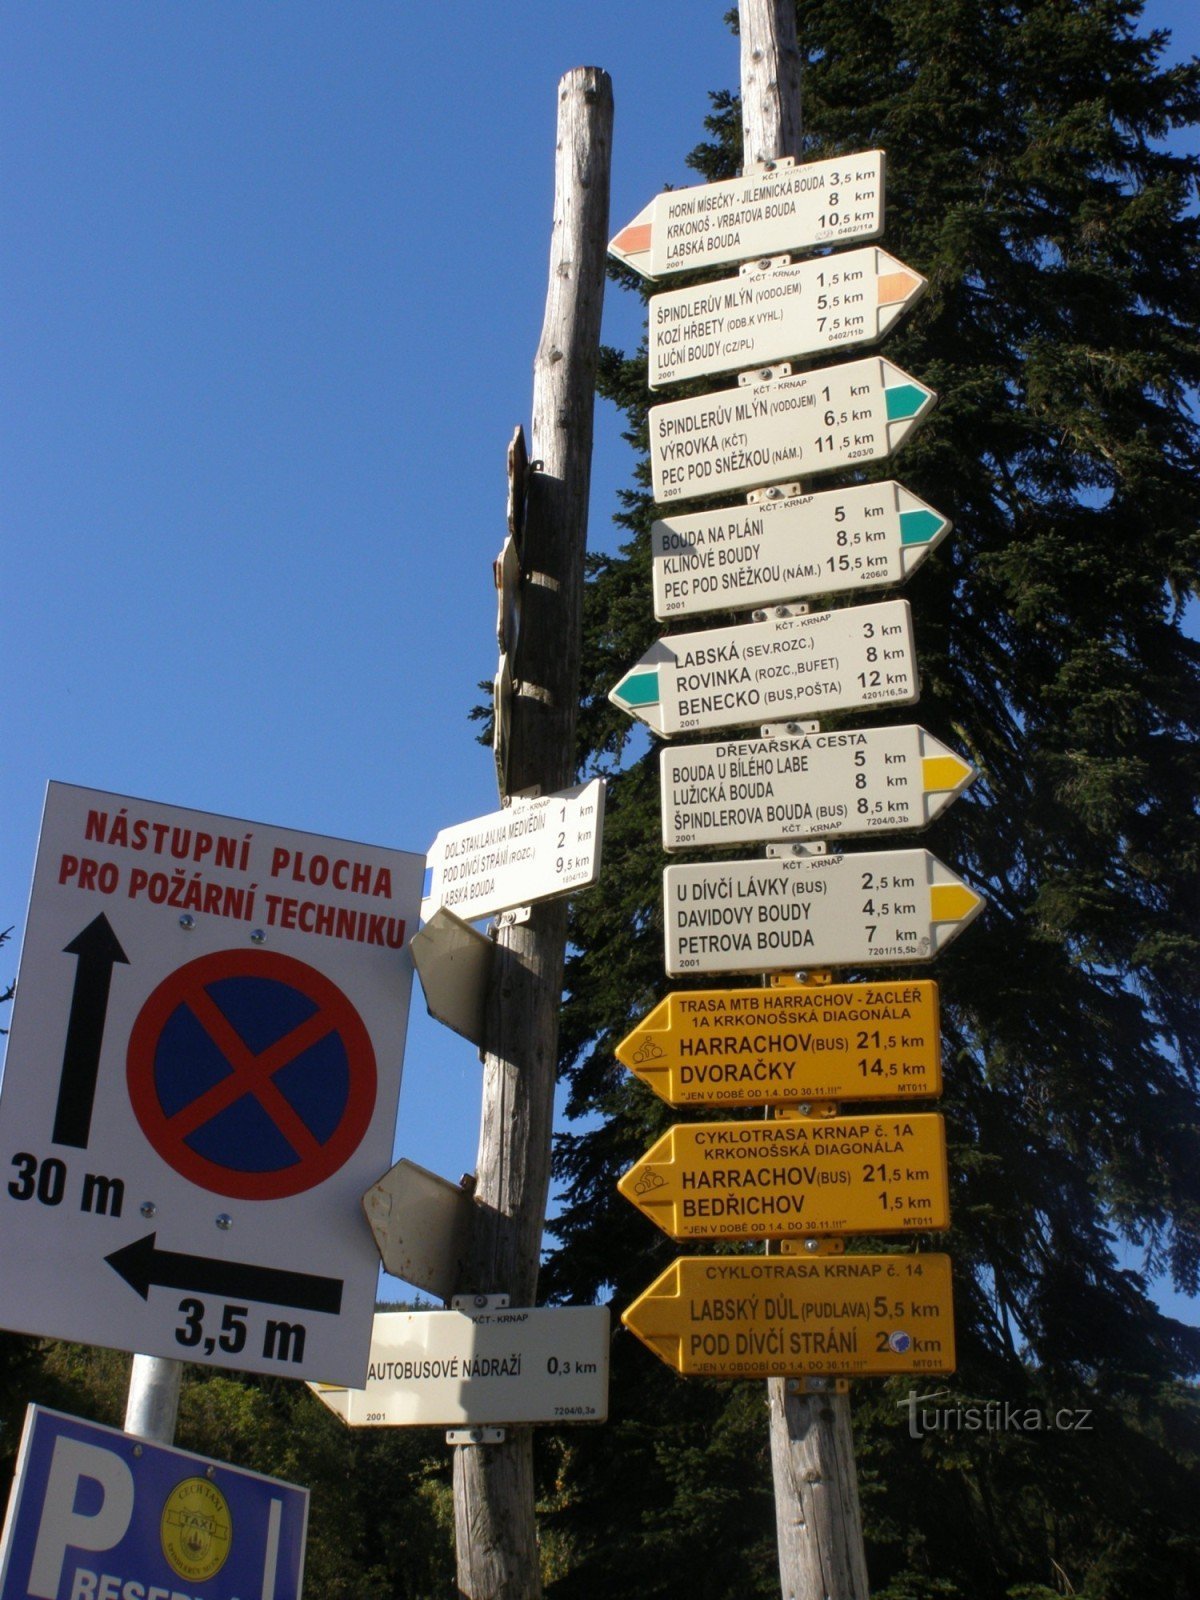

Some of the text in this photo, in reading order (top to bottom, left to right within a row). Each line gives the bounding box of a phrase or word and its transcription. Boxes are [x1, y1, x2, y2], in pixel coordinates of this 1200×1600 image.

[669, 172, 851, 218] HORNÍ MÍSEČKY JILEMNICKÁ BOUDA 3,5
[667, 192, 839, 239] KRKONOŠ VRBATOVA BOUDA 8
[667, 212, 850, 259] LABSKÁ BOUDA 10,5
[724, 273, 839, 309] MLÝN (VODOJEM) 1,5
[658, 328, 681, 347] KOZÍ
[683, 318, 724, 340] HŘBETY
[757, 309, 783, 326] VYHL.)
[817, 295, 840, 309] 5,5
[828, 329, 863, 341] 0402/11b
[658, 317, 840, 368] LUČNÍ BOUDY (CZ/PL) 7,5
[735, 387, 830, 421] MLÝN (VODOJEM) 1
[661, 410, 848, 461] VÝROVKA (KČT) 6,5
[663, 435, 850, 485] PEC POD SNĚŽKOU (NÁM.) 11,5
[848, 448, 874, 459] 4203/0
[664, 487, 682, 497] 2001
[663, 506, 845, 550] BOUDA NA PLÁNI 5
[663, 530, 861, 574] KLÍNOVÉ BOUDY 8,5
[665, 555, 862, 599] PEC POD SNĚŽKOU (NÁM.) 15,5
[860, 570, 888, 580] 4206/0
[666, 601, 685, 610] 2001
[801, 614, 832, 627] KRNAP
[675, 623, 874, 669] LABSKÁ (SEV.ROZC.) 3
[677, 667, 751, 692] ROVINKA
[866, 647, 878, 662] 8
[679, 670, 881, 716] BENECKO (BUS,POŠTA) 12
[680, 719, 700, 728] 2001
[716, 733, 867, 758] DŘEVAŘSKÁ CESTA
[673, 751, 865, 783] BOUDA U BÍLÉHO LABE 5
[673, 774, 867, 806] LUŽICKÁ BOUDA 8
[560, 806, 566, 822] 1
[674, 798, 882, 831] ŠPINDLEROVA BOUDA (BUS) 8,5
[867, 816, 909, 827] 7204/0,3b
[676, 834, 696, 843] 2001
[85, 808, 393, 899] NÁSTUPNÍ PLOCHA
[443, 832, 565, 884] POD 2
[811, 856, 843, 869] KRNAP
[470, 857, 572, 897] BOUDA 9,5
[677, 873, 888, 901] U DÍVČÍ LÁVKY (BUS) 2,5
[58, 854, 407, 949] PRO POŽÁRNÍ TECHNIKU
[678, 899, 889, 928] DAVIDOVY BOUDY 4,5
[679, 925, 877, 954] PETROVA BOUDA 7
[868, 945, 916, 956] 7201/15,5b
[680, 998, 726, 1013] TRASA
[731, 998, 760, 1010] MTB
[763, 994, 853, 1009] HARRACHOV
[693, 1008, 911, 1028] 1A KRKONOŠSKÁ DIAGONÁLA
[857, 1031, 896, 1051] 21,5
[681, 1059, 898, 1084] DVORAČKY 14,5
[898, 1083, 927, 1093] MT011
[695, 1124, 913, 1145] CYKLOTRASA KRNAP č. 1A
[704, 1142, 903, 1160] KRKONOŠSKÁ DIAGONÁLA
[8, 1152, 125, 1218] 30 m
[863, 1164, 901, 1184] 21,5
[684, 1192, 903, 1217] BEDŘICHOV 1,5
[903, 1217, 933, 1226] MT011
[706, 1264, 923, 1280] CYKLOTRASA KRNAP č. 14
[691, 1294, 759, 1321] LABSKÝ
[874, 1296, 904, 1318] 5,5
[175, 1298, 306, 1364] 3,5 m
[691, 1334, 729, 1355] POD
[736, 1328, 784, 1355] DÍVČÍ
[790, 1327, 858, 1353] STRÁNÍ
[368, 1353, 570, 1381] AUTOBUSOVÉ NÁDRAŽÍ 0,3
[913, 1359, 942, 1368] MT011
[27, 1435, 134, 1600] P
[185, 1515, 213, 1530] TAXI
